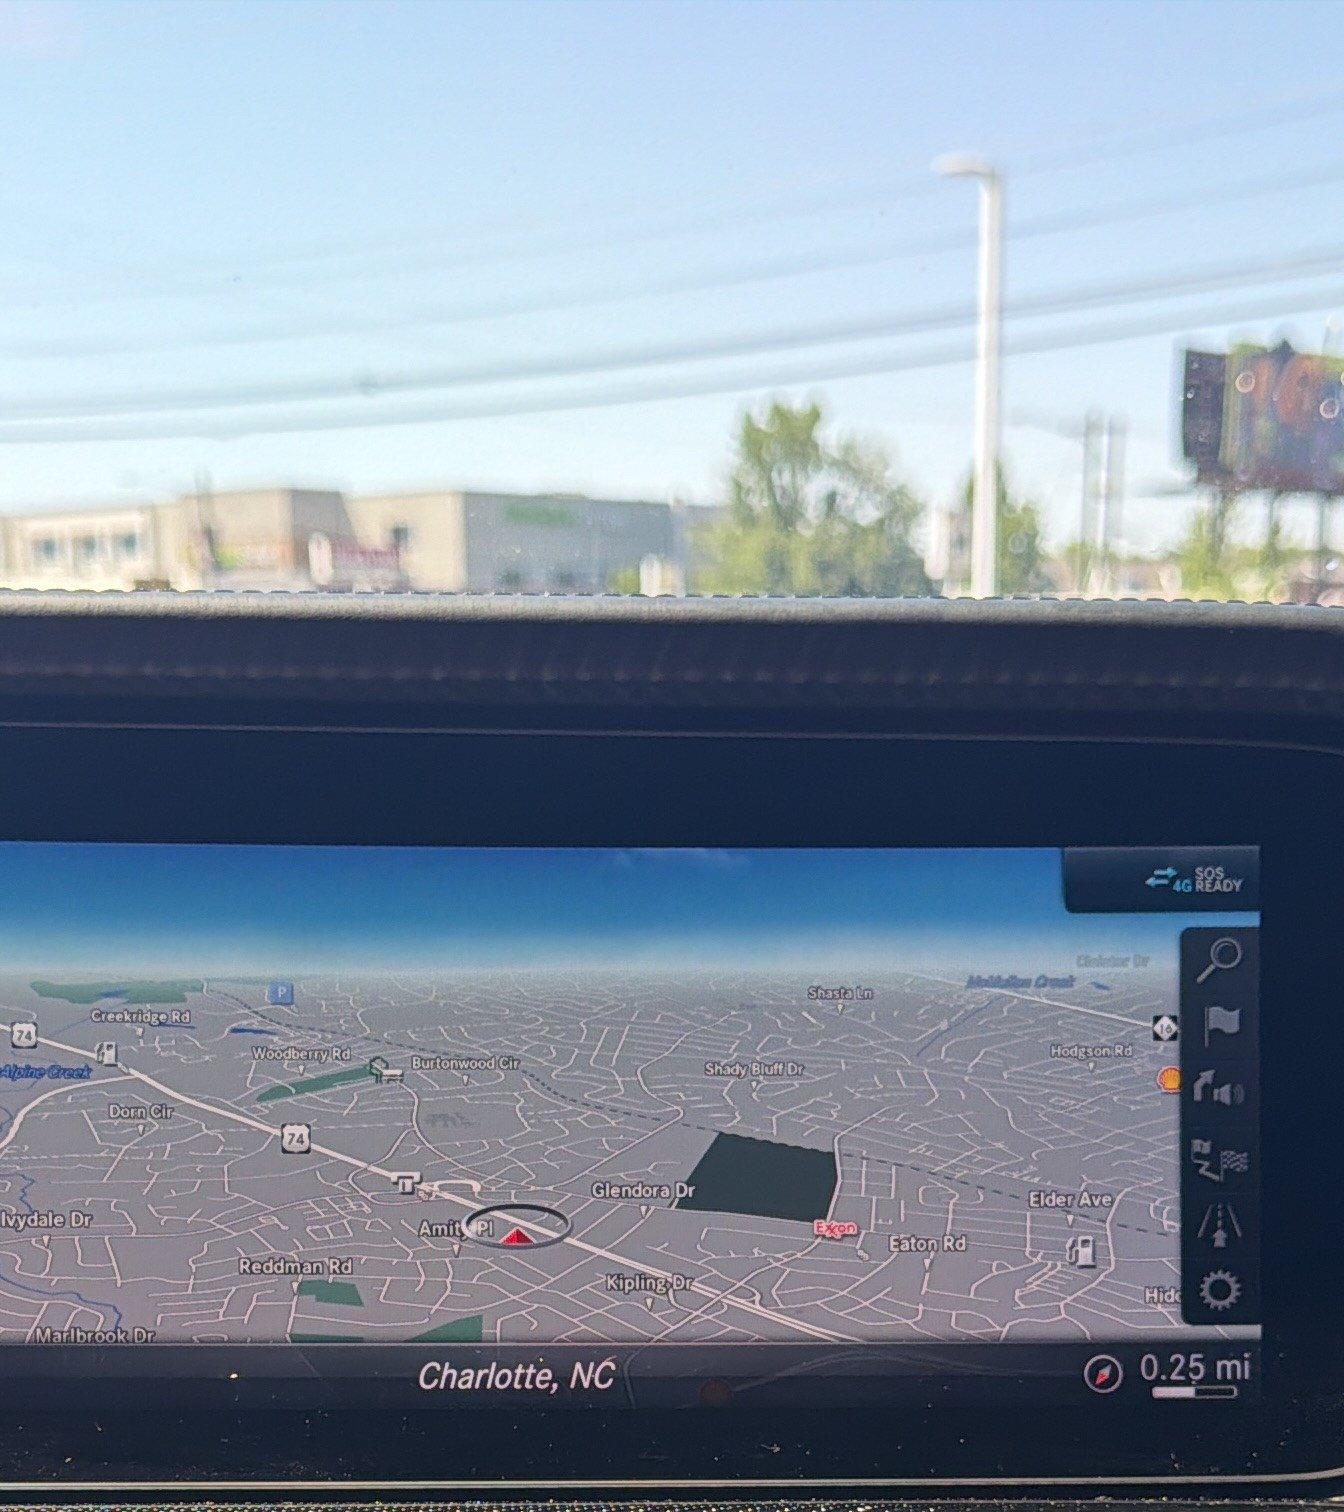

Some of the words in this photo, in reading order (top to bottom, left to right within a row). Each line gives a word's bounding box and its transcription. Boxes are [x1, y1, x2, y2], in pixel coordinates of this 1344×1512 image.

[1195, 867, 1224, 880] SOS
[1172, 880, 1192, 892] 4G
[1196, 880, 1243, 892] READY
[808, 986, 853, 1000] Shasta
[857, 987, 873, 1000] Ln
[91, 1011, 167, 1025] Creekridge
[172, 1011, 190, 1023] Rd
[15, 1030, 32, 1042] 74
[253, 1047, 329, 1064] Woodberry
[332, 1047, 351, 1061] Rd
[1051, 1045, 1111, 1060] Hodgson
[1113, 1045, 1133, 1058] Rd
[412, 1056, 494, 1069] Burtonwood
[499, 1056, 519, 1069] Cir
[705, 1062, 747, 1078] Shady
[751, 1062, 784, 1075] Bluff
[787, 1062, 804, 1076] Dr
[47, 1064, 93, 1079] Creek
[109, 1105, 145, 1119] Dorn
[150, 1104, 173, 1118] Cir
[287, 1132, 304, 1147] 74
[592, 1183, 669, 1199] Glendora
[674, 1183, 695, 1198] Dr
[1029, 1192, 1074, 1207] Elder
[1078, 1192, 1113, 1207] Ave
[1, 1212, 64, 1230] Ivydale
[68, 1212, 93, 1228] Dr
[889, 1236, 937, 1251] Eaton
[943, 1236, 966, 1251] Rd
[239, 1258, 324, 1275] Reddman
[328, 1258, 353, 1275] Rd
[606, 1275, 665, 1293] Kipling
[672, 1276, 693, 1291] Dr
[35, 1329, 127, 1344] Marlbrook
[132, 1329, 156, 1344] Dr
[1140, 1353, 1205, 1381] 0.25
[1217, 1353, 1250, 1380] mi
[418, 1362, 559, 1393] Charlotte,
[570, 1361, 616, 1388] NC
